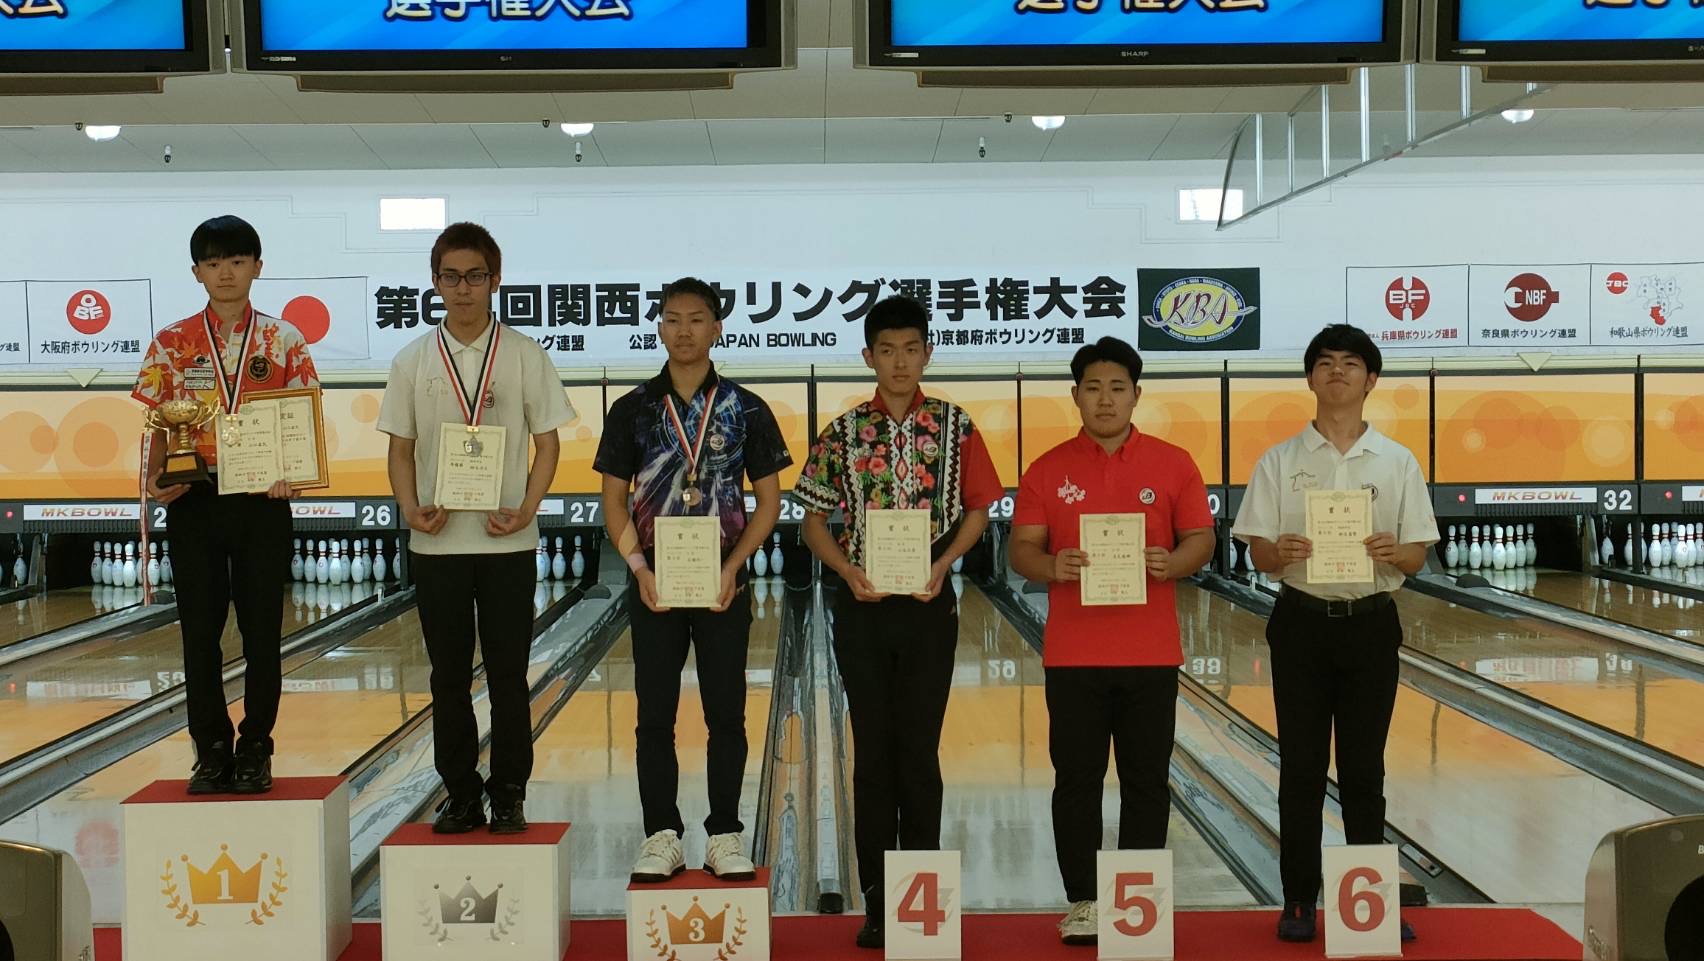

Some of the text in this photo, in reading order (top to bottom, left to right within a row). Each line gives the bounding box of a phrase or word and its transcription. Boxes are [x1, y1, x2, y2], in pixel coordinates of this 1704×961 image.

[374, 275, 1127, 329] 第6回関西ウリング選手権大会
[1525, 289, 1547, 305] NBF
[536, 334, 585, 352] グ連盟
[629, 334, 658, 350] 公認
[766, 332, 837, 348] BOWLING
[1381, 328, 1458, 341] 兵庫県ボウリング連盟
[1481, 328, 1577, 339] 奈良県ボウリング連盟
[1609, 325, 1689, 339] 和歌山県ボウリング連盟
[41, 340, 140, 354] 大阪府ボウリング連盟
[988, 495, 1015, 518] 29
[1207, 493, 1220, 515] 0
[1491, 491, 1583, 501] MKBOWL
[1603, 489, 1633, 511] 32
[41, 507, 133, 517] MKBOWL
[153, 506, 167, 528] 2
[292, 505, 341, 515] OWL
[361, 504, 392, 527] 26
[570, 501, 600, 523] 27
[216, 869, 234, 900] 1
[459, 897, 476, 922] 2
[897, 872, 946, 937] 4
[1112, 871, 1158, 937] 5
[1337, 866, 1386, 933] 6
[688, 917, 706, 943] 3
